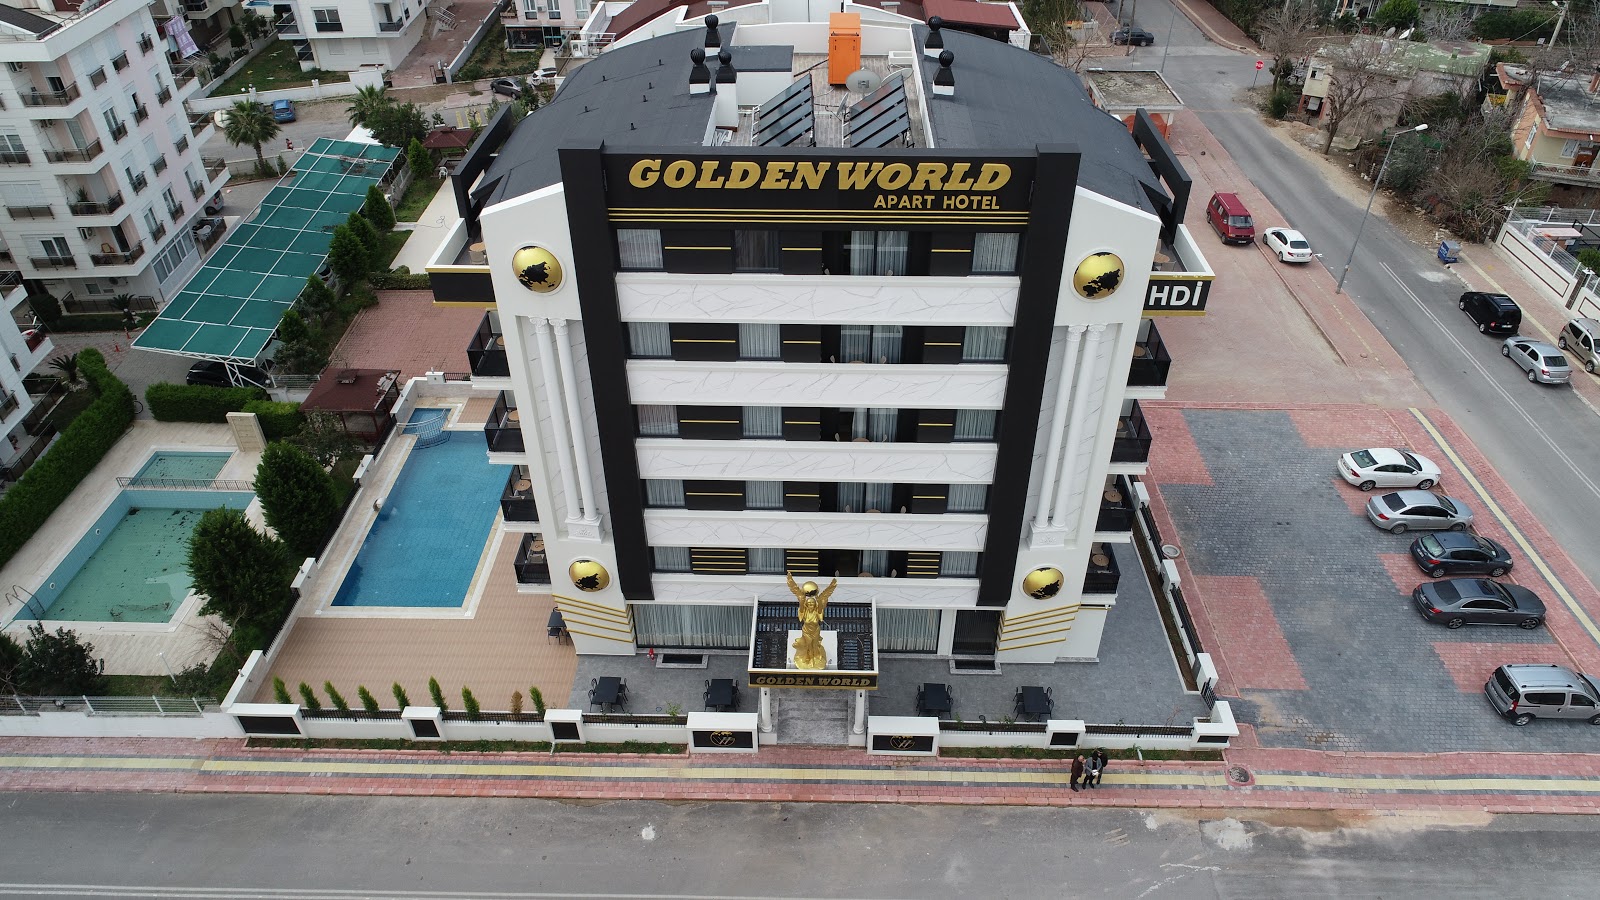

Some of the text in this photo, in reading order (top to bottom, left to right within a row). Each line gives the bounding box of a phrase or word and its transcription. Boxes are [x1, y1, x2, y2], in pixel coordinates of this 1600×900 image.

[628, 159, 1012, 191] GOLDEN WORLD
[873, 194, 1000, 210] APART HOTEL
[756, 676, 871, 686] GOLDEN WORLD
